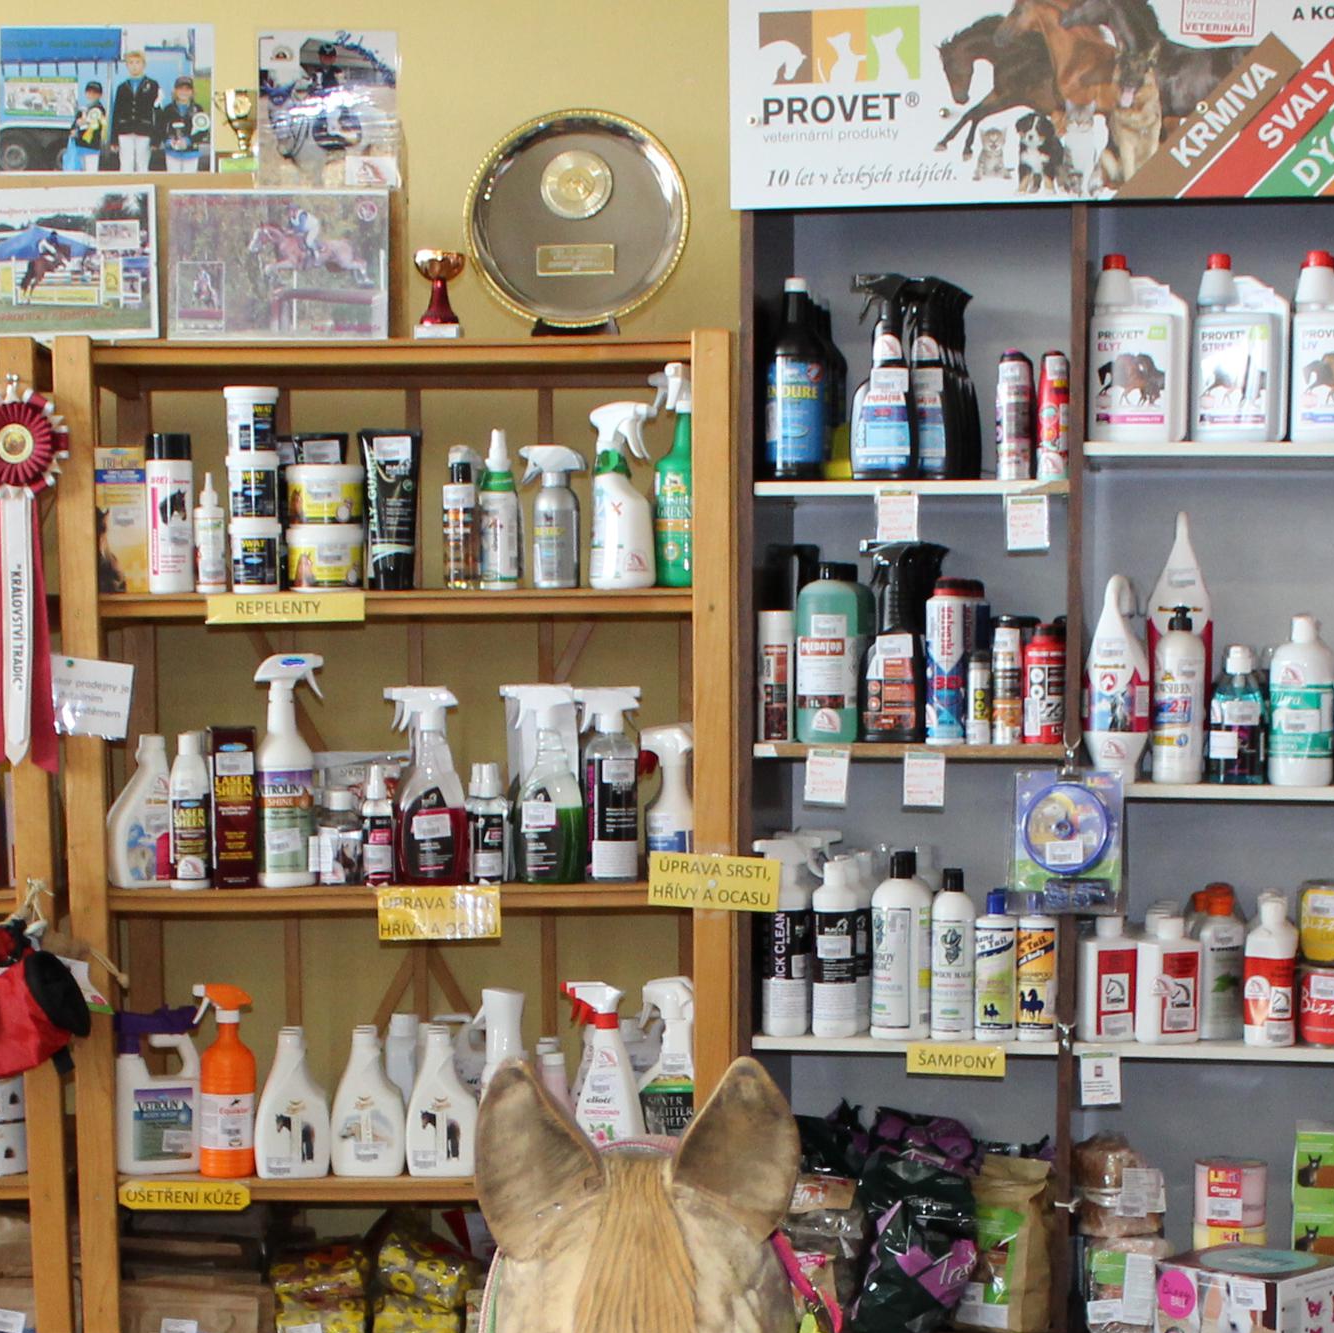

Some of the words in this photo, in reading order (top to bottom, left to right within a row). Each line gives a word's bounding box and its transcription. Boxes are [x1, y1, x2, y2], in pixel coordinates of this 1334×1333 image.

[1292, 6, 1305, 20] A
[1184, 21, 1251, 33] VETERINÁŘI
[1169, 60, 1278, 169] KRMIVA
[762, 128, 835, 144] veterinární
[837, 126, 900, 142] produkty
[765, 168, 790, 187] 10
[794, 165, 815, 186] let
[818, 171, 829, 185] v
[832, 163, 892, 188] českých
[235, 600, 322, 617] REPELENTY
[658, 855, 723, 877] ÚPRAVA
[725, 862, 772, 882] SRSTI,
[652, 880, 699, 901] HŘÍVY
[702, 888, 716, 902] A
[717, 888, 771, 907] OCASU
[777, 912, 786, 947] CLEAN
[917, 1045, 998, 1070] ŠAMPONY
[125, 1185, 200, 1204] OŠETŘENÍ
[203, 1188, 242, 1207] KŮŽE
